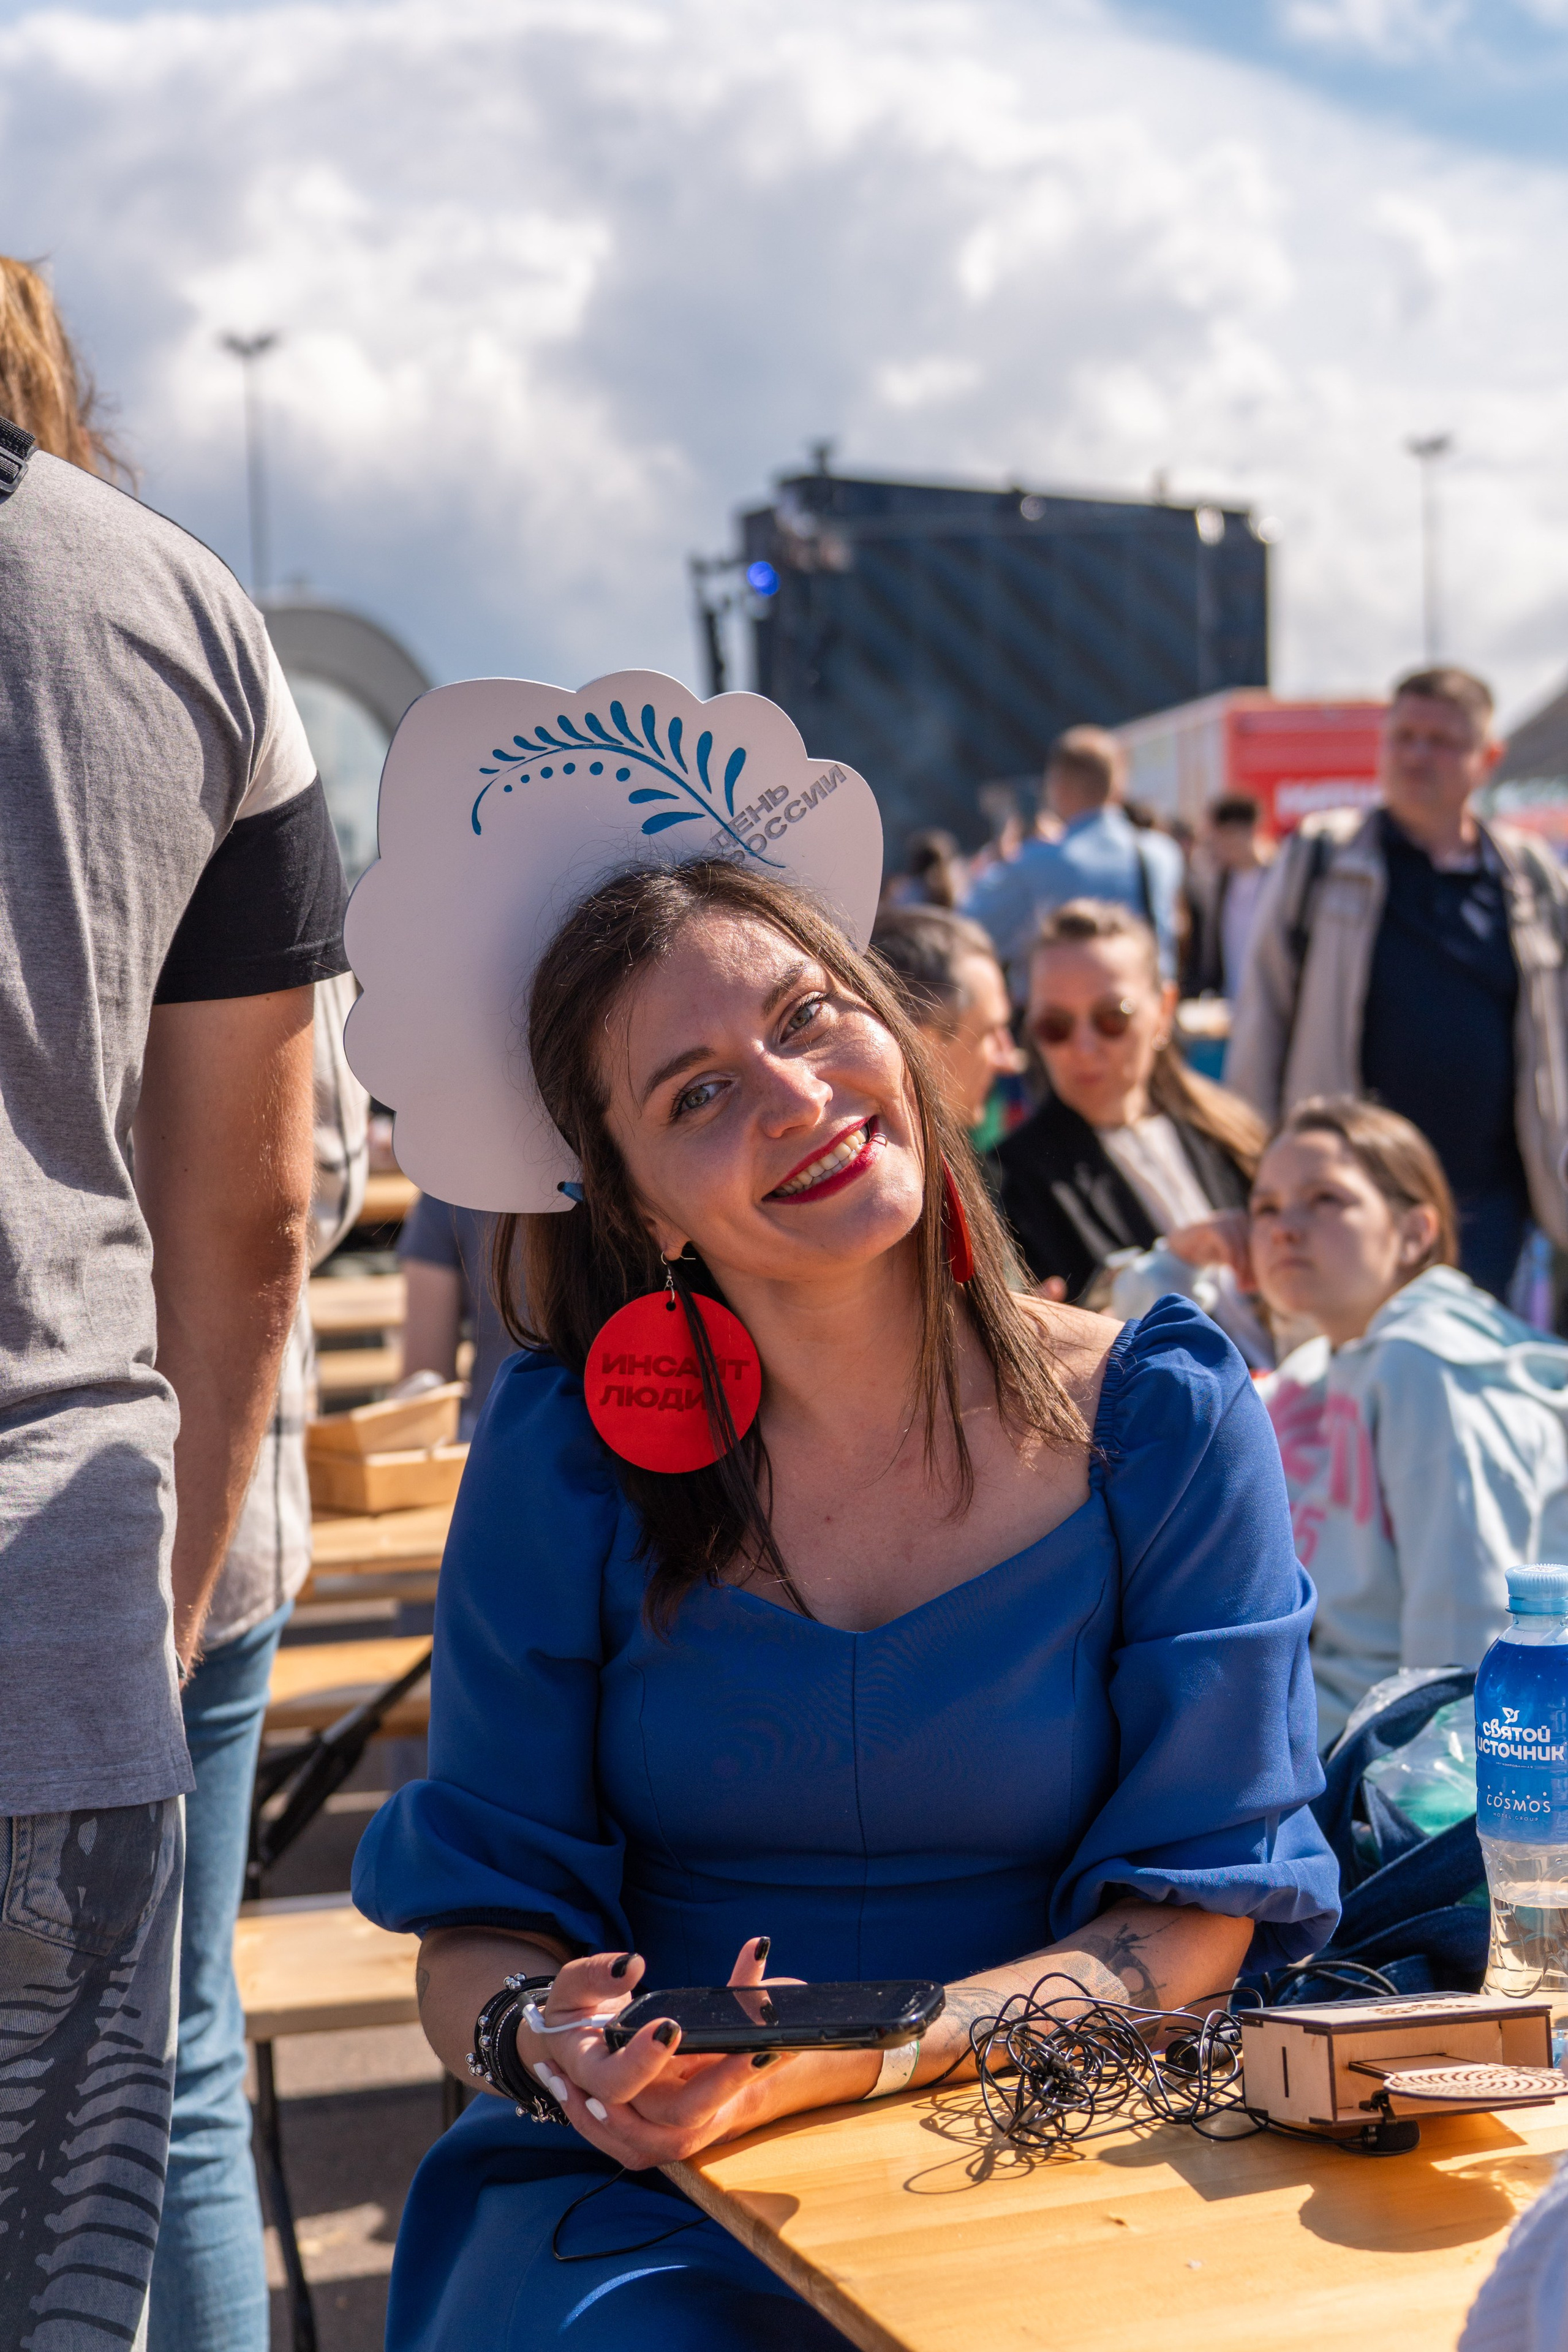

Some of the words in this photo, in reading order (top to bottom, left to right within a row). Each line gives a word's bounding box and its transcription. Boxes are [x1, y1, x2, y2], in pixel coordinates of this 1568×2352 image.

[710, 785, 789, 851] ДЕНЬ
[599, 1385, 708, 1412] ЛЮДИ
[1487, 1794, 1551, 1813] COSMOS
